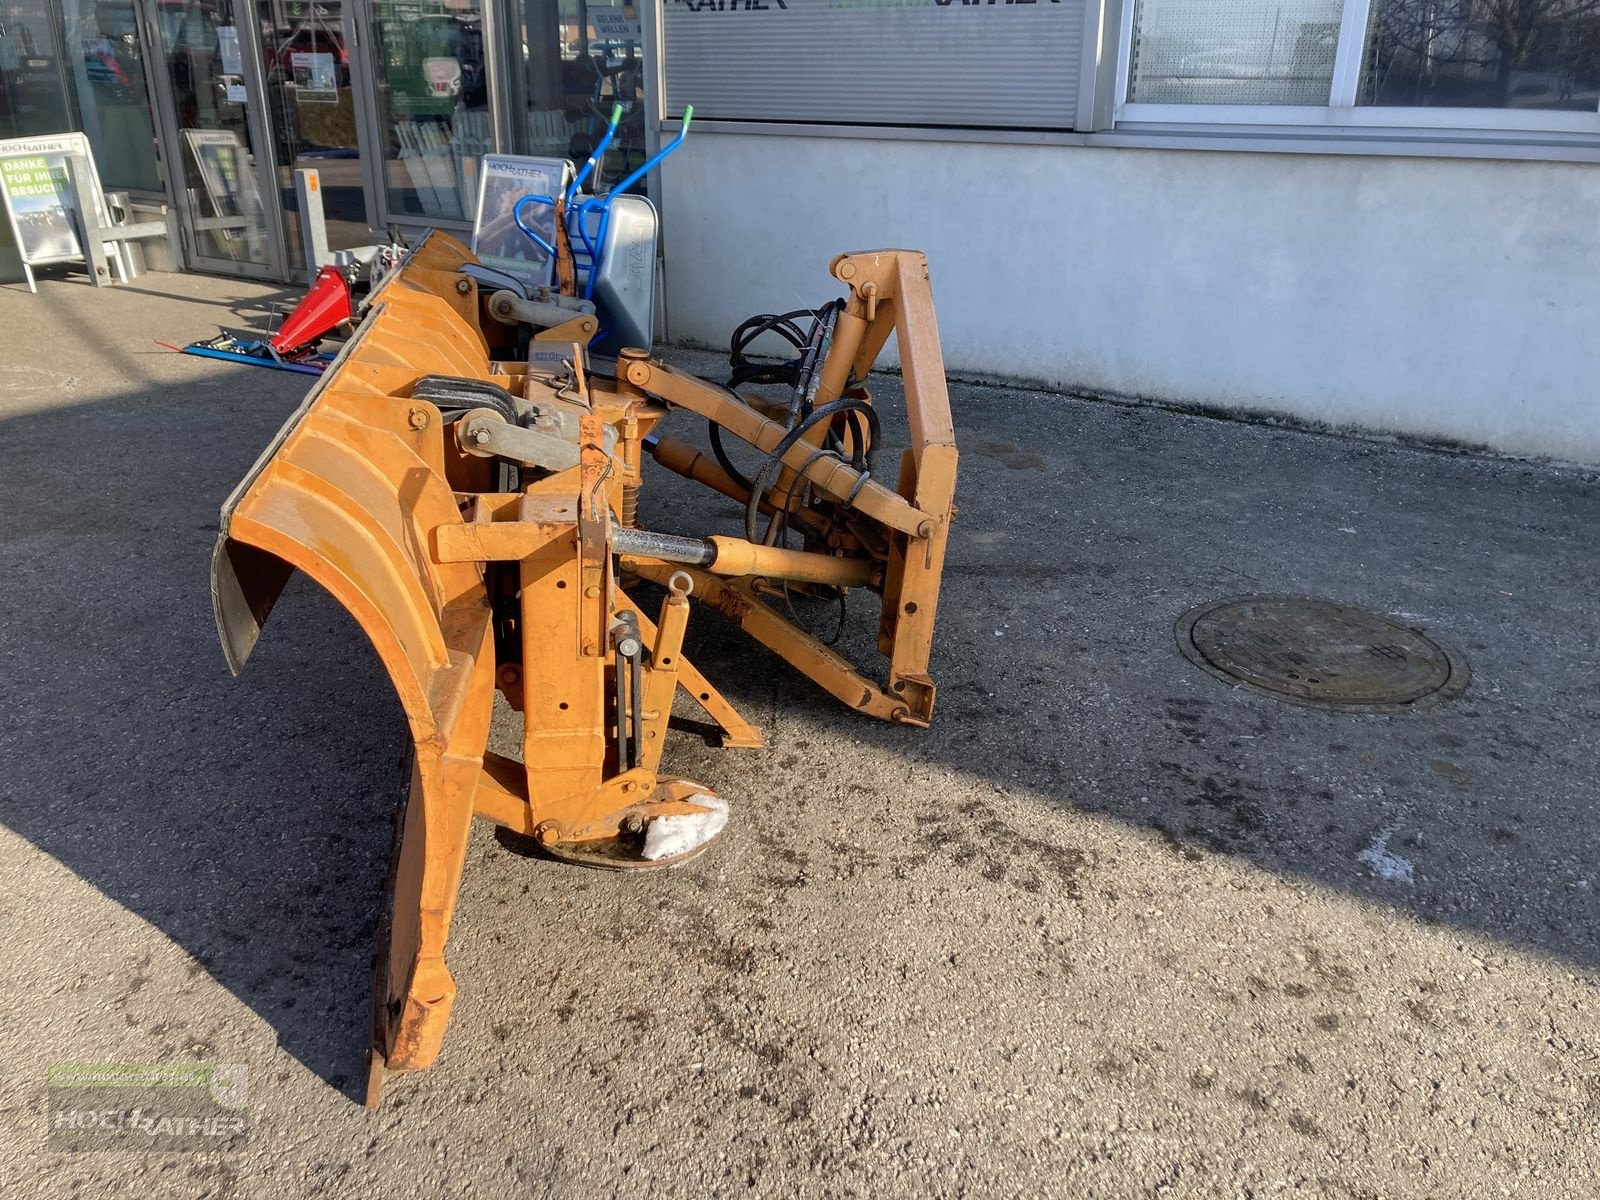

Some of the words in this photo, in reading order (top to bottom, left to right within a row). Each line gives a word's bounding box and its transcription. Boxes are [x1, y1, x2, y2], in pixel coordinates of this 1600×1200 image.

[3, 159, 45, 171] DANKE
[489, 162, 544, 178] HOCHRATHER
[7, 172, 32, 184] FÜR
[34, 171, 63, 181] IHRE
[11, 183, 64, 195] BESUCH!
